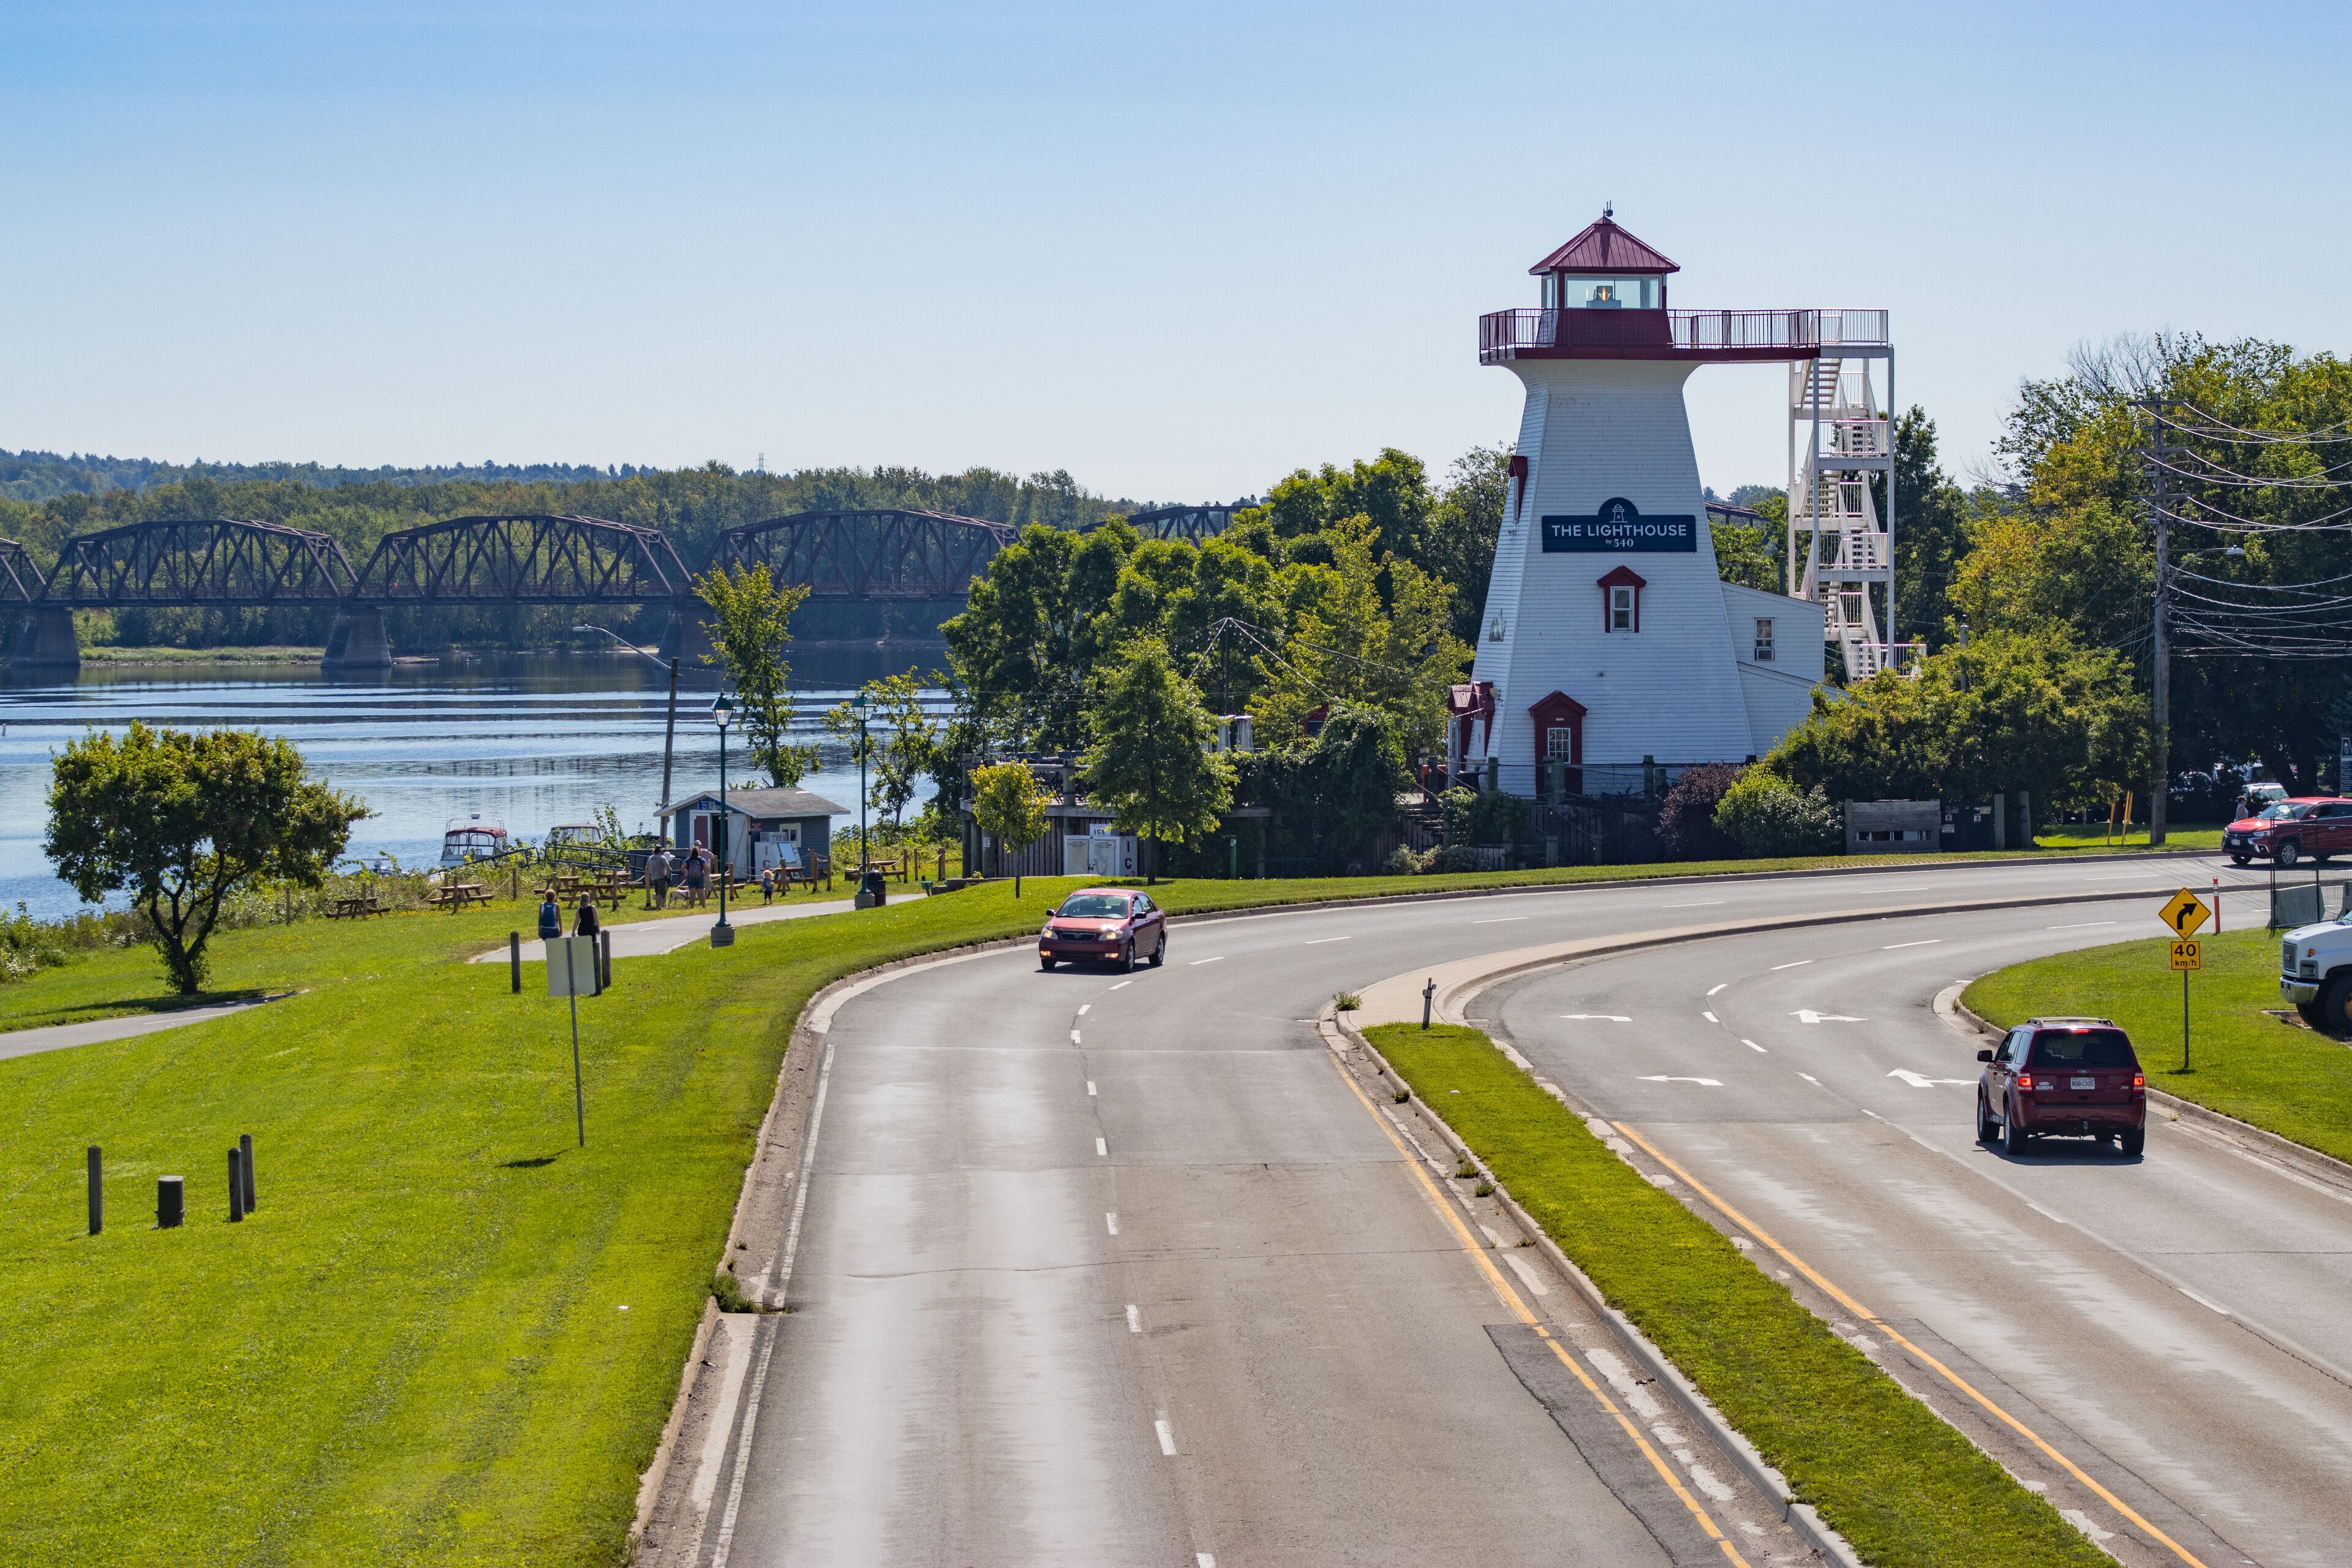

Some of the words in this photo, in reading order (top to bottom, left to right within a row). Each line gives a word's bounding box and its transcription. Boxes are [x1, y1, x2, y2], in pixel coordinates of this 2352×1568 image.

[1551, 525, 1581, 537] THE
[1588, 524, 1686, 537] LIGHTHOUSE
[1613, 538, 1634, 548] 540
[2174, 944, 2196, 957] 40
